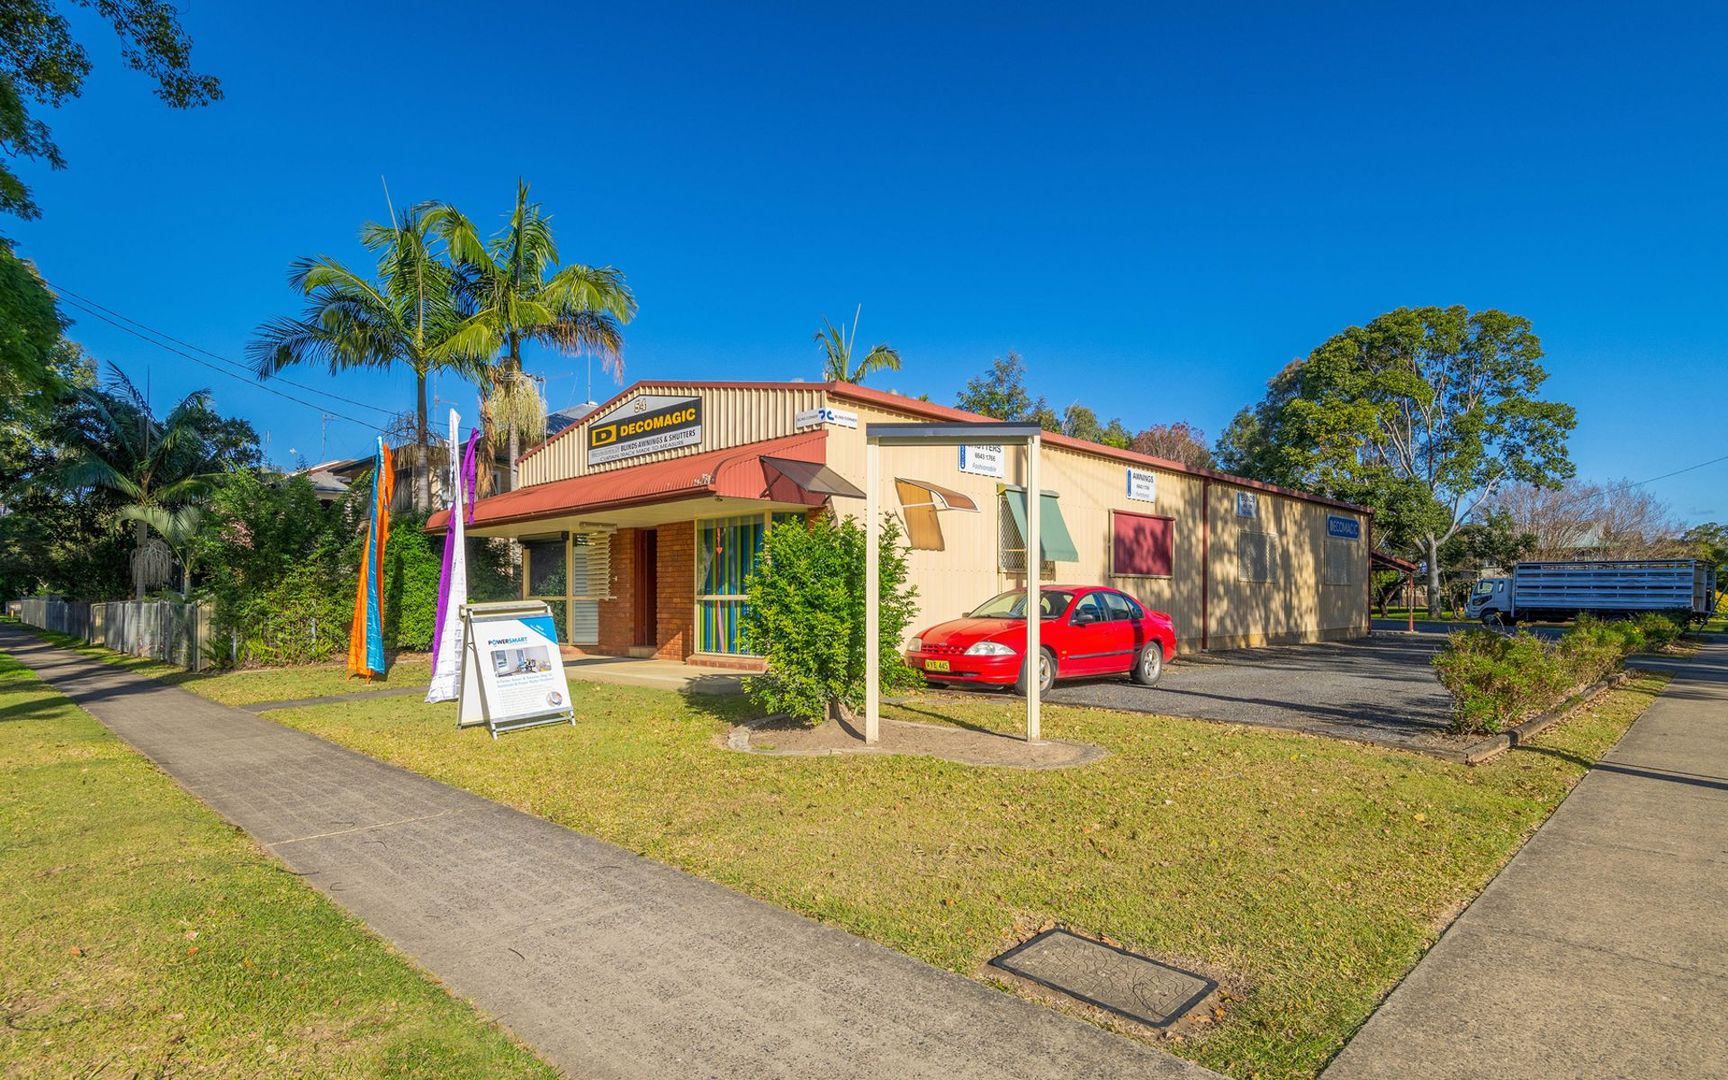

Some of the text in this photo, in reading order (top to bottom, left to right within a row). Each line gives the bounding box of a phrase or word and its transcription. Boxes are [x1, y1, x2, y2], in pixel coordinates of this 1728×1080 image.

[634, 398, 647, 413] 54
[620, 408, 696, 437] DECOMAGIC
[620, 441, 638, 452] BLINDS
[638, 436, 663, 448] AWNINGS
[669, 429, 696, 442] SHUTTERS
[636, 447, 650, 455] MADE
[660, 440, 684, 449] MEASURE
[1133, 472, 1154, 483] AWNINGS
[488, 637, 527, 646] POWERSMART
